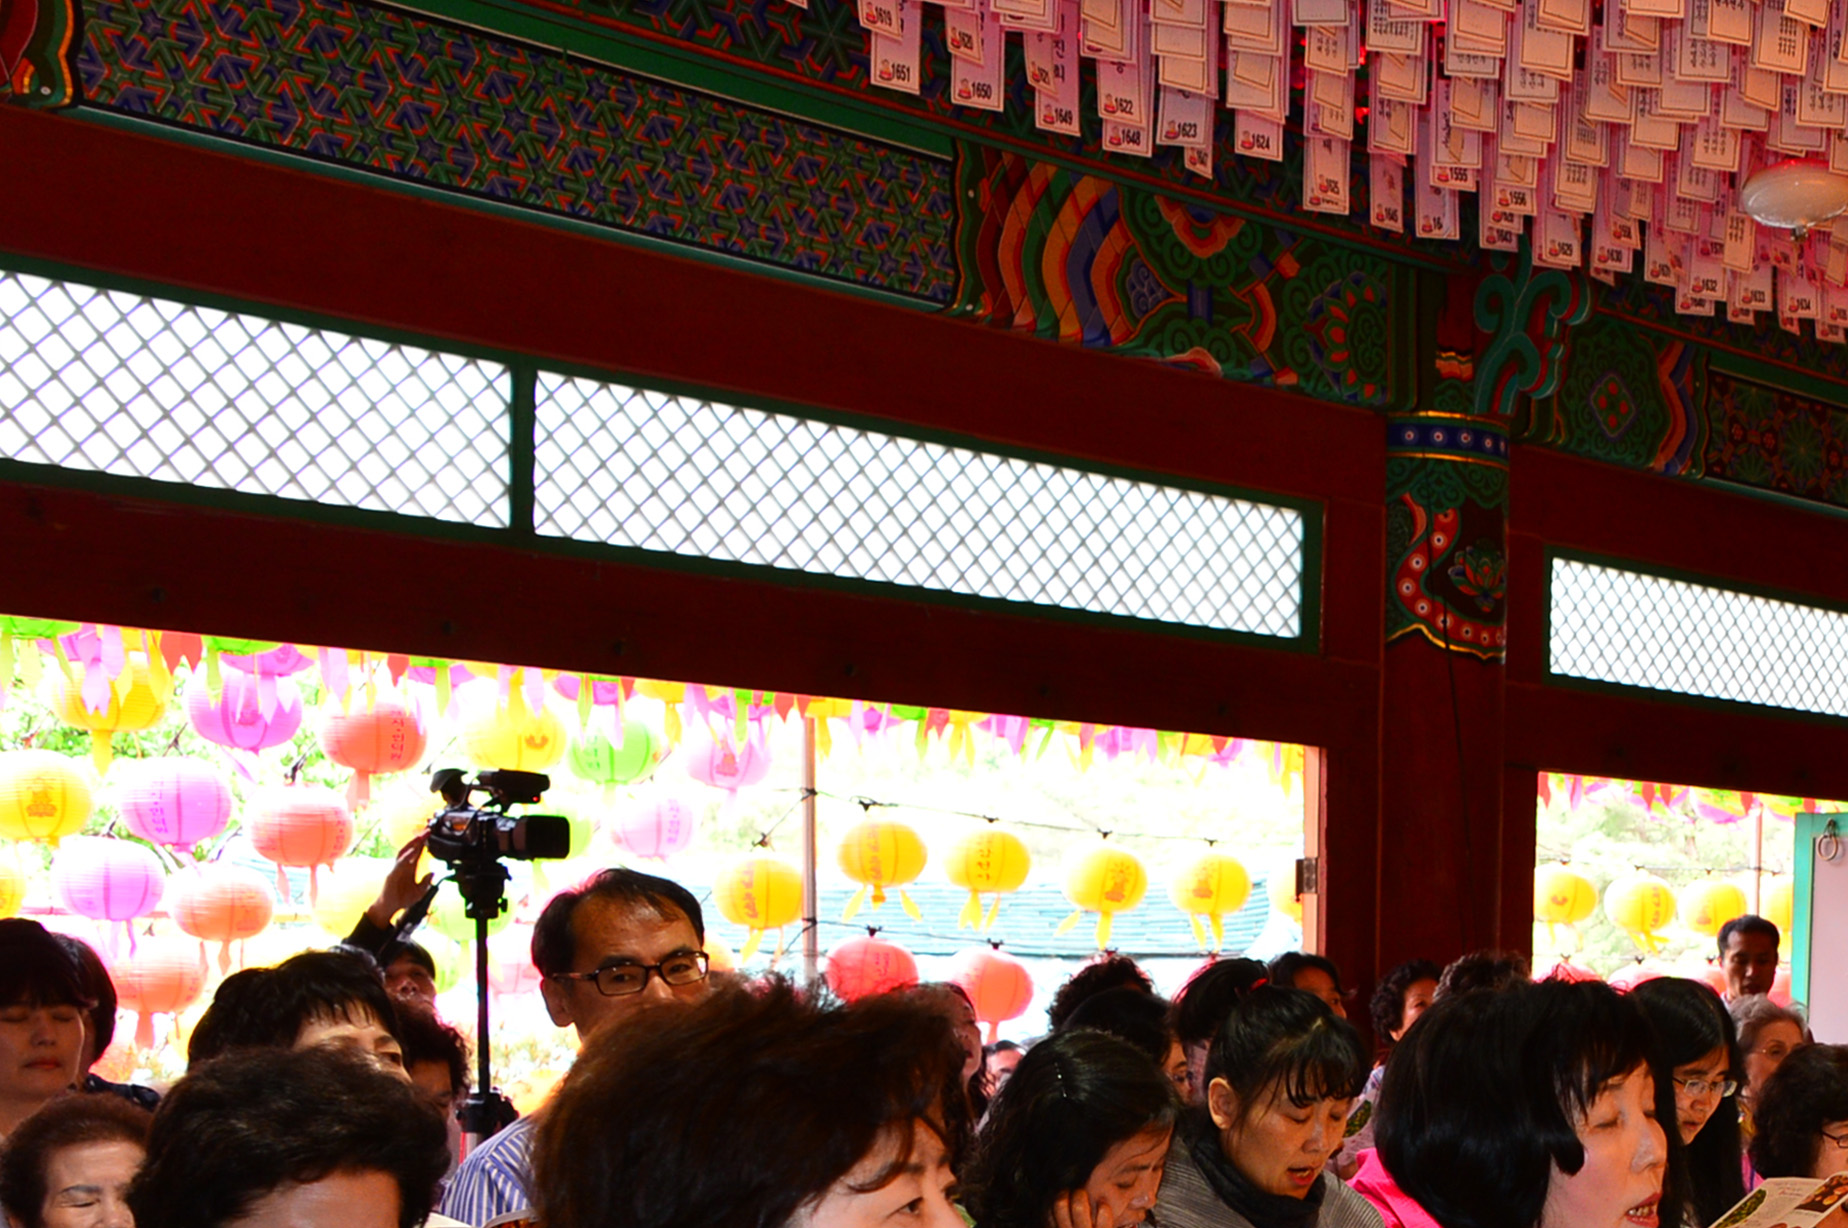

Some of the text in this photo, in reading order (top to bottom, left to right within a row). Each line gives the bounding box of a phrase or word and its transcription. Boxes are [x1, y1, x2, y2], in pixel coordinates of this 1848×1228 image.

[890, 62, 911, 82] 1651
[971, 82, 992, 100] 1650
[1114, 97, 1134, 115] 1622
[1054, 107, 1073, 125] 1649
[1121, 129, 1141, 146] 1648
[1178, 123, 1198, 138] 1623
[1252, 133, 1270, 150] 1624
[1449, 167, 1468, 183] 1555
